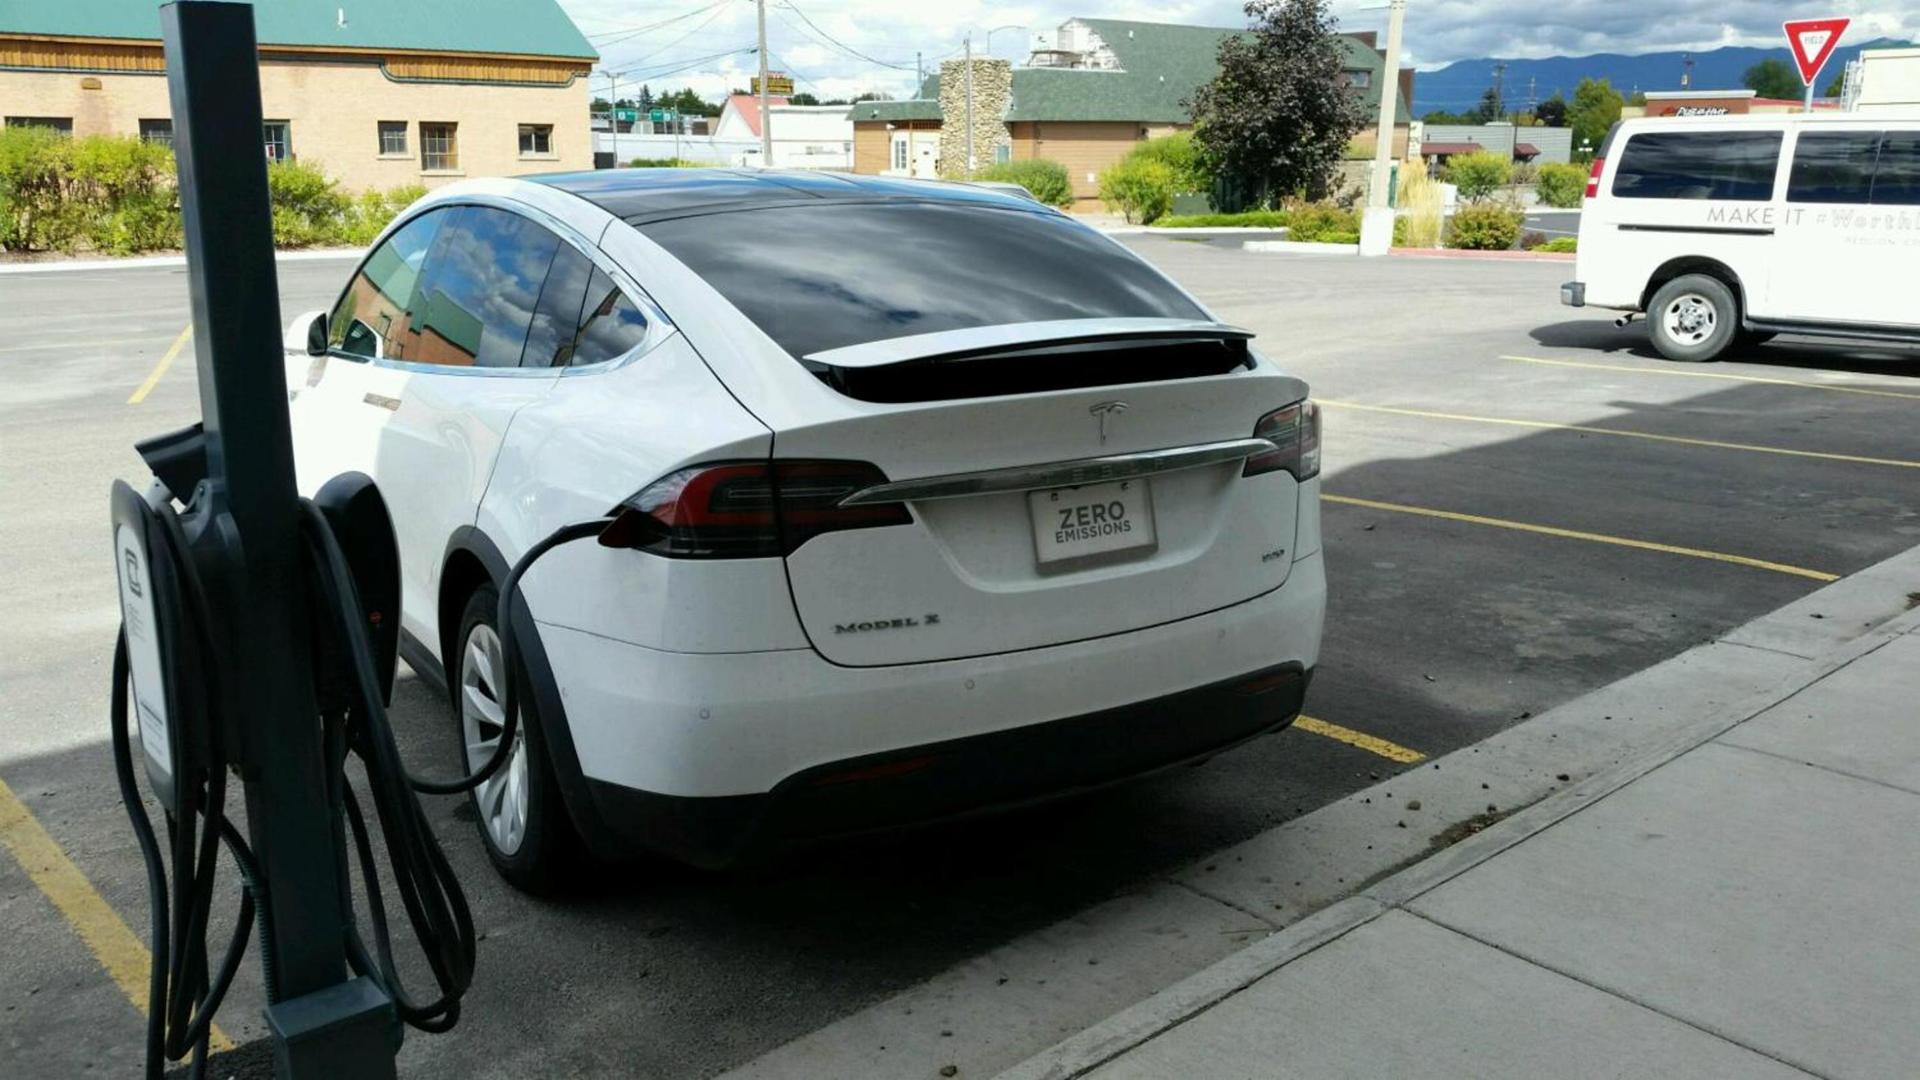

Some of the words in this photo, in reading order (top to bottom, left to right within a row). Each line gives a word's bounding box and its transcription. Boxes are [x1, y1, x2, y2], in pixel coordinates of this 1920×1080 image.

[1707, 207, 1775, 225] MAKE
[1785, 208, 1805, 226] IT
[1059, 500, 1125, 529] ZERO
[1055, 520, 1132, 544] EMISSIONS
[834, 617, 919, 635] MODEL
[924, 613, 941, 626] X
